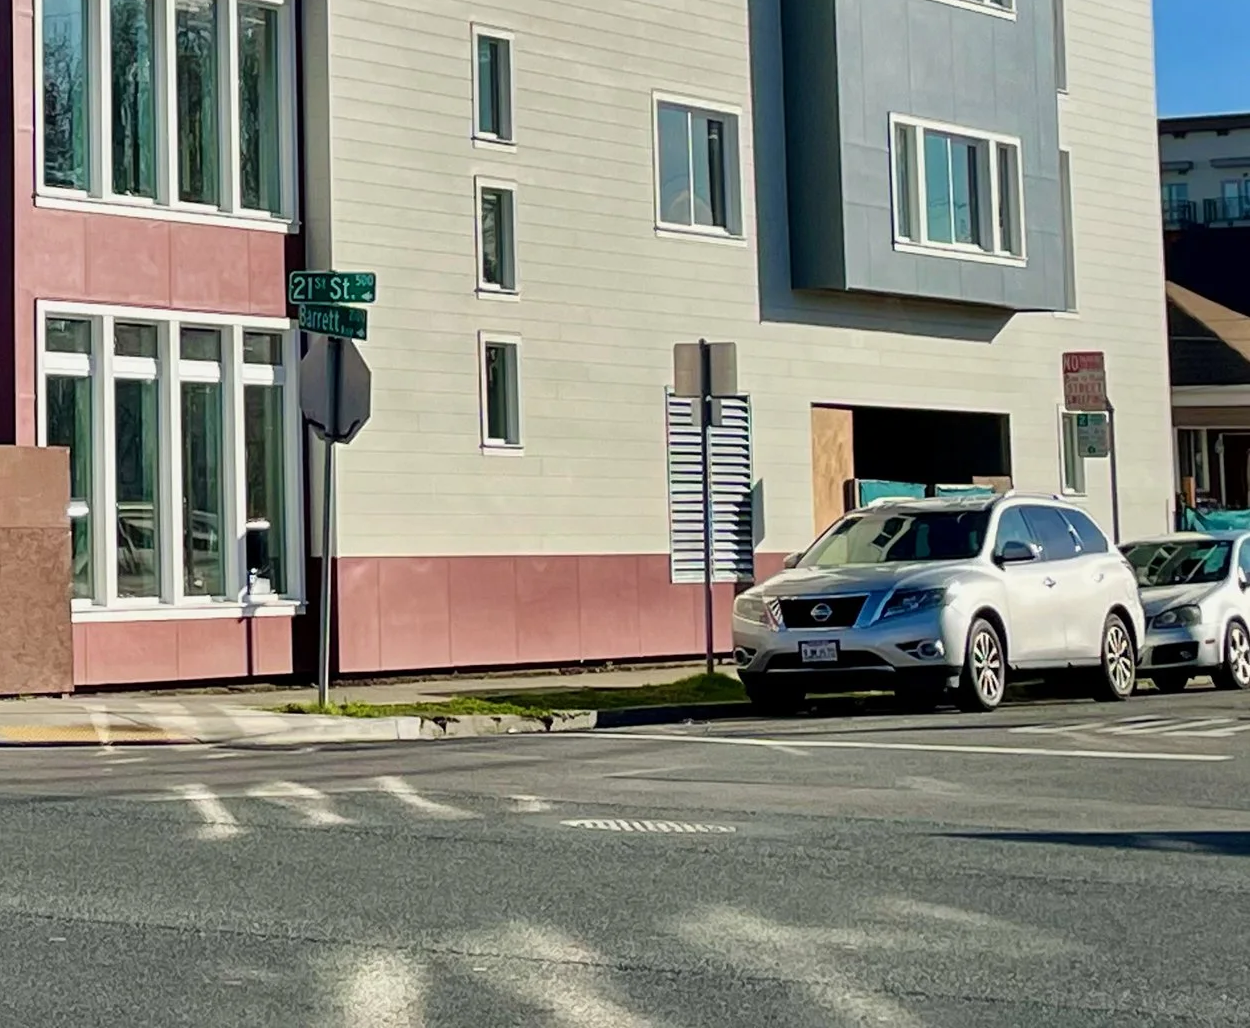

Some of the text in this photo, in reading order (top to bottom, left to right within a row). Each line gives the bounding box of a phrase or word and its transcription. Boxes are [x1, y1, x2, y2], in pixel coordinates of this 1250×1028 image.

[354, 274, 374, 286] 500
[299, 304, 339, 332] Barrett
[1064, 354, 1079, 371] NO
